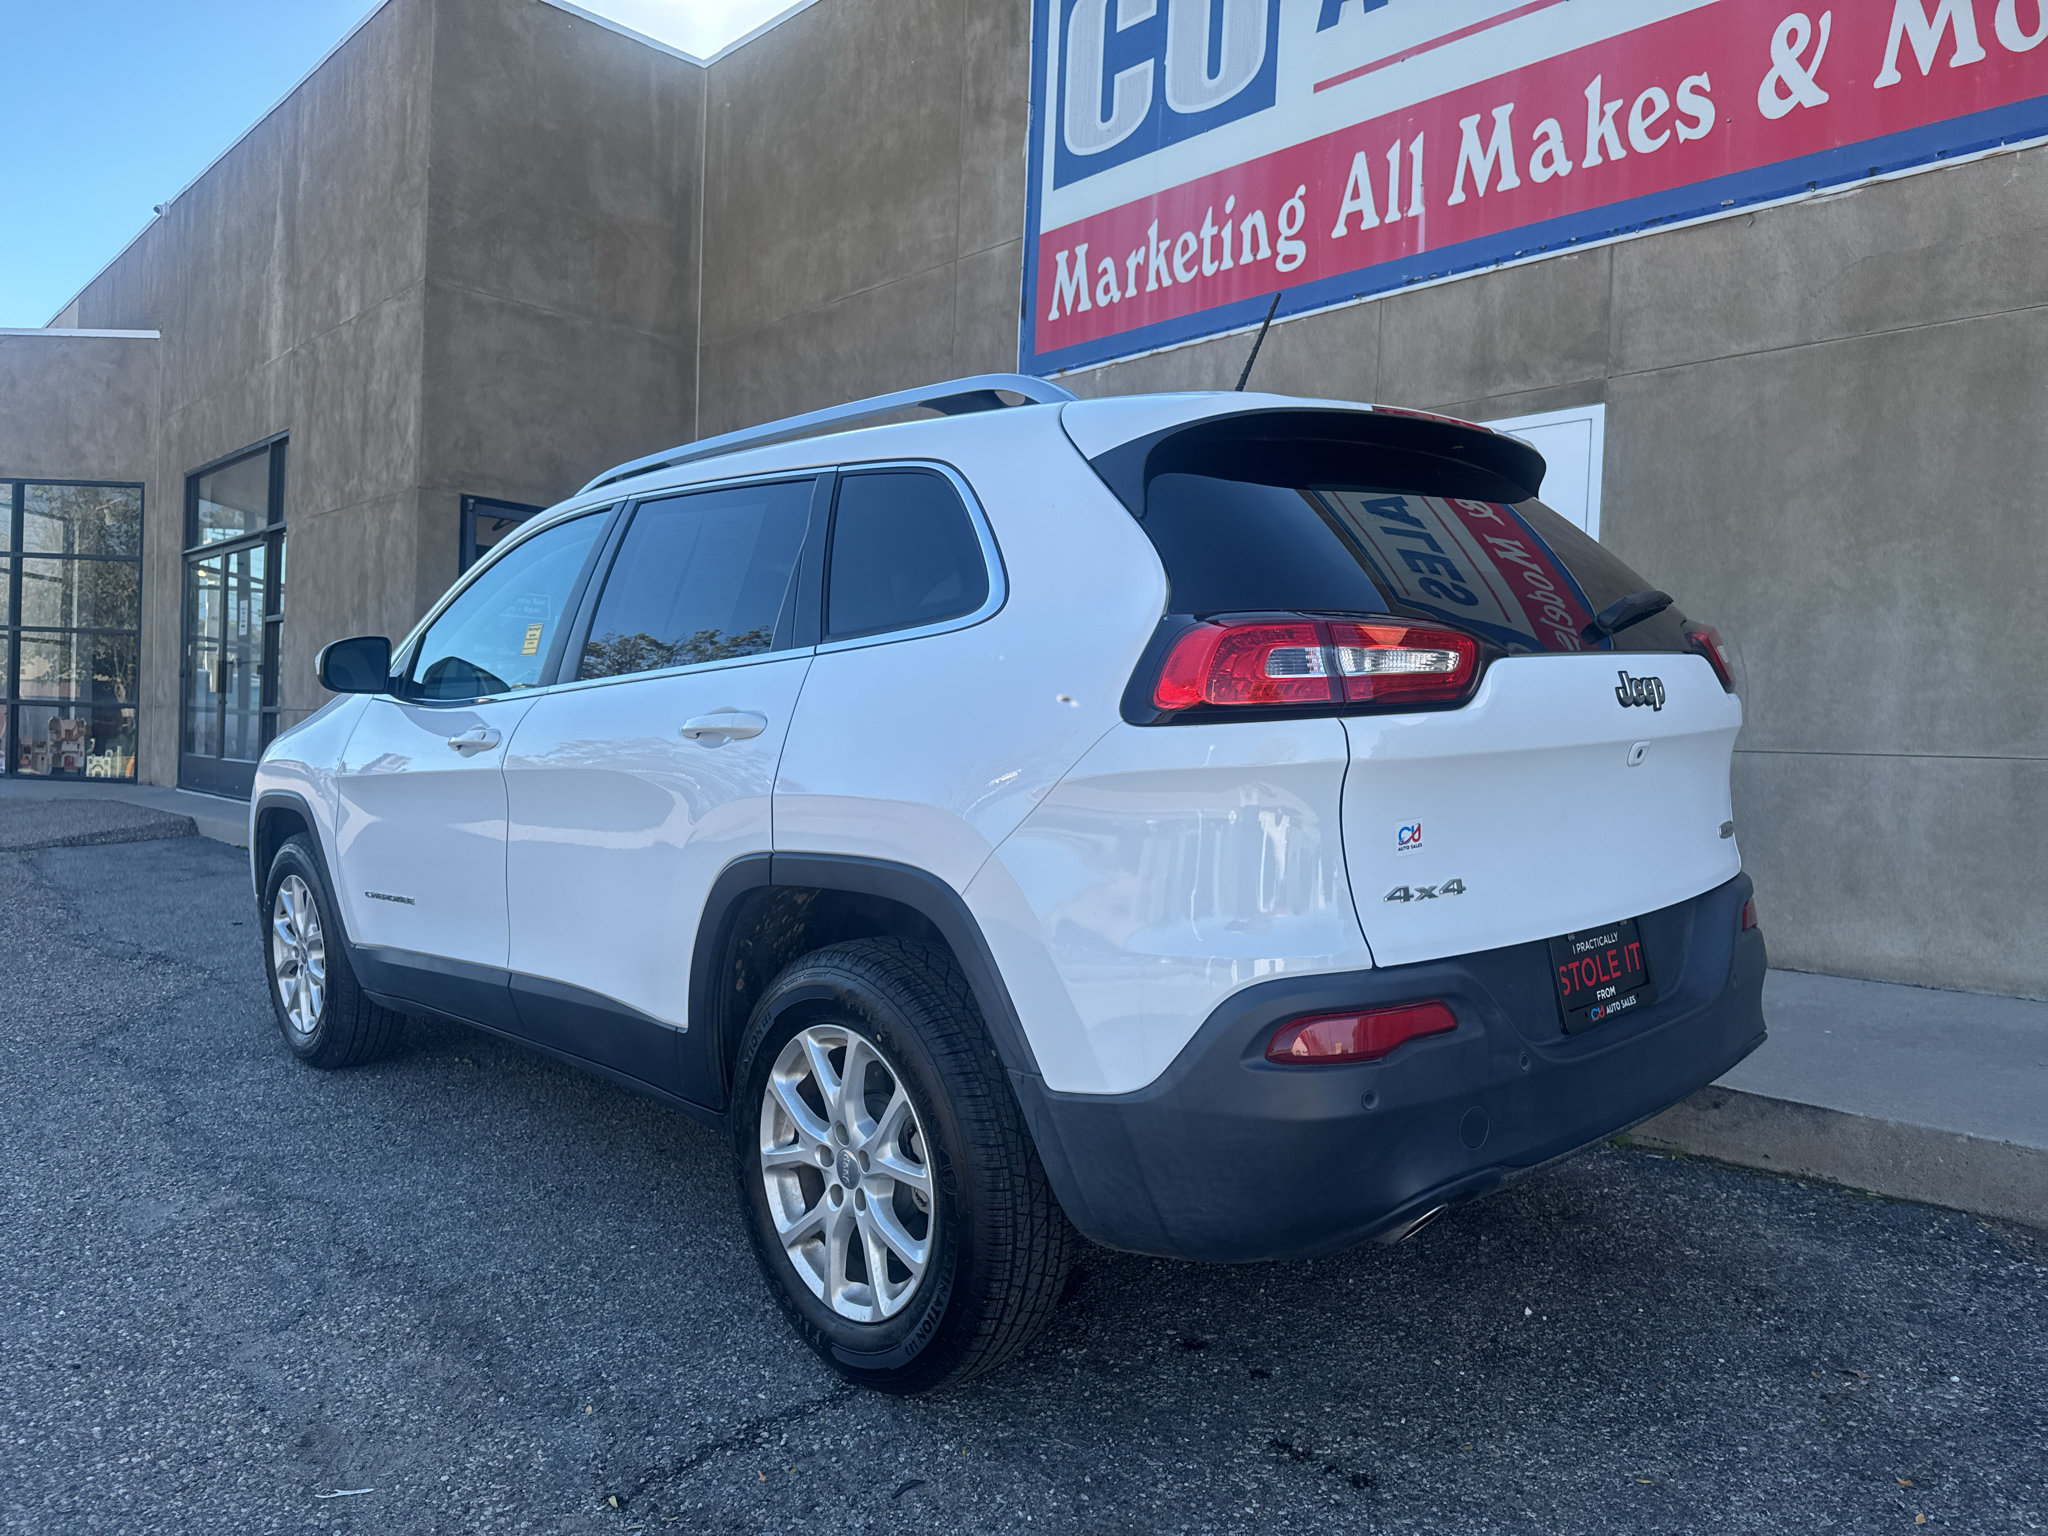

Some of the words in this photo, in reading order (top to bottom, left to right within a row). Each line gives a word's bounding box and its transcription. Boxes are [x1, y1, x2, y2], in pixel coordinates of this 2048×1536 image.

[1064, 0, 1268, 155] CU
[1048, 184, 1306, 321] Marketing
[1331, 131, 1425, 239] All
[1447, 72, 1716, 206] Makes
[1757, 10, 1832, 120] &
[1615, 671, 1666, 712] Jeep
[1383, 878, 1467, 903] 4x4
[1576, 931, 1619, 954] PRACTICALLY
[1559, 949, 1621, 996] STOLE
[1624, 942, 1640, 973] IT
[1596, 986, 1617, 1001] FROM
[1606, 1001, 1621, 1014] AUTO
[1621, 995, 1637, 1008] SALES
